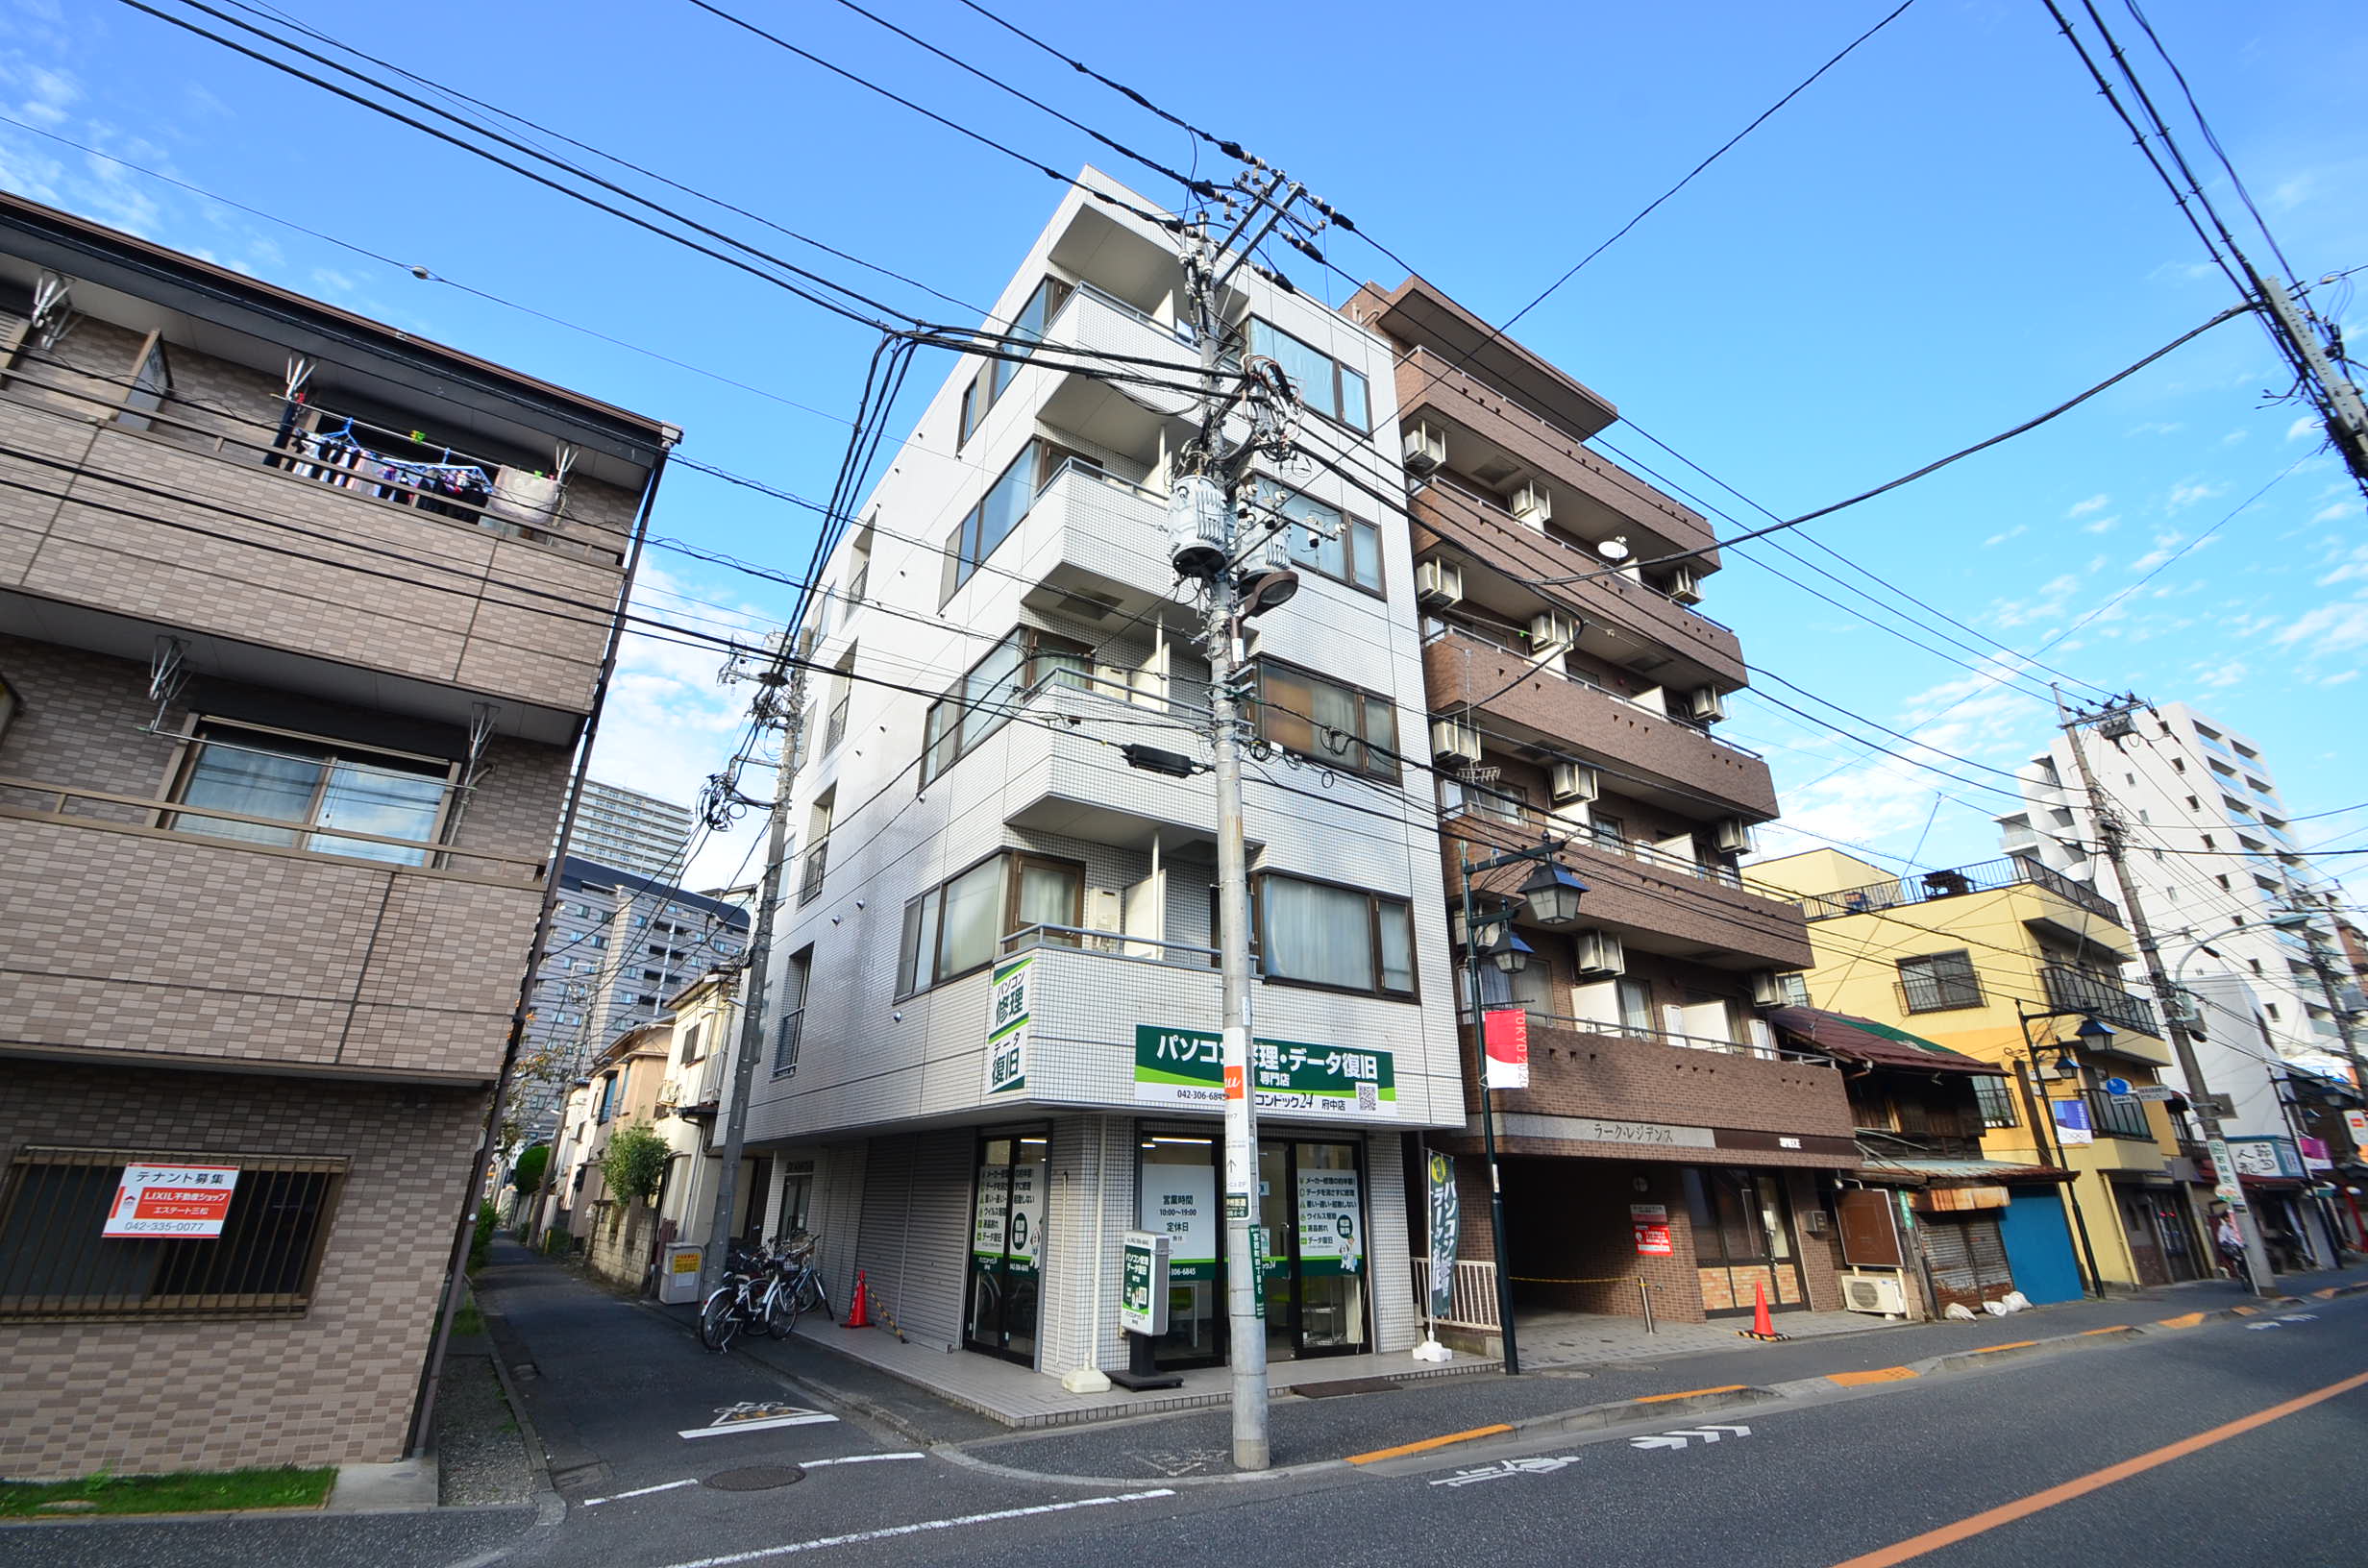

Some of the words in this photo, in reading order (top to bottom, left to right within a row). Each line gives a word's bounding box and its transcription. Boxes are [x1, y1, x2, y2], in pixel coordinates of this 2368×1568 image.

[997, 971, 1025, 998] パソコン
[996, 985, 1024, 1027] 修理
[1516, 1008, 1527, 1052] TOKYO
[994, 1032, 1021, 1057] データ
[992, 1047, 1020, 1088] 復旧
[1260, 1071, 1290, 1087] 専門店
[1321, 1099, 1346, 1111] 府中店
[136, 1171, 225, 1186] テナント募集
[1163, 1195, 1194, 1206] 営業時間
[124, 1222, 205, 1231] 042-335-0077
[1166, 1222, 1190, 1232] 定休日
